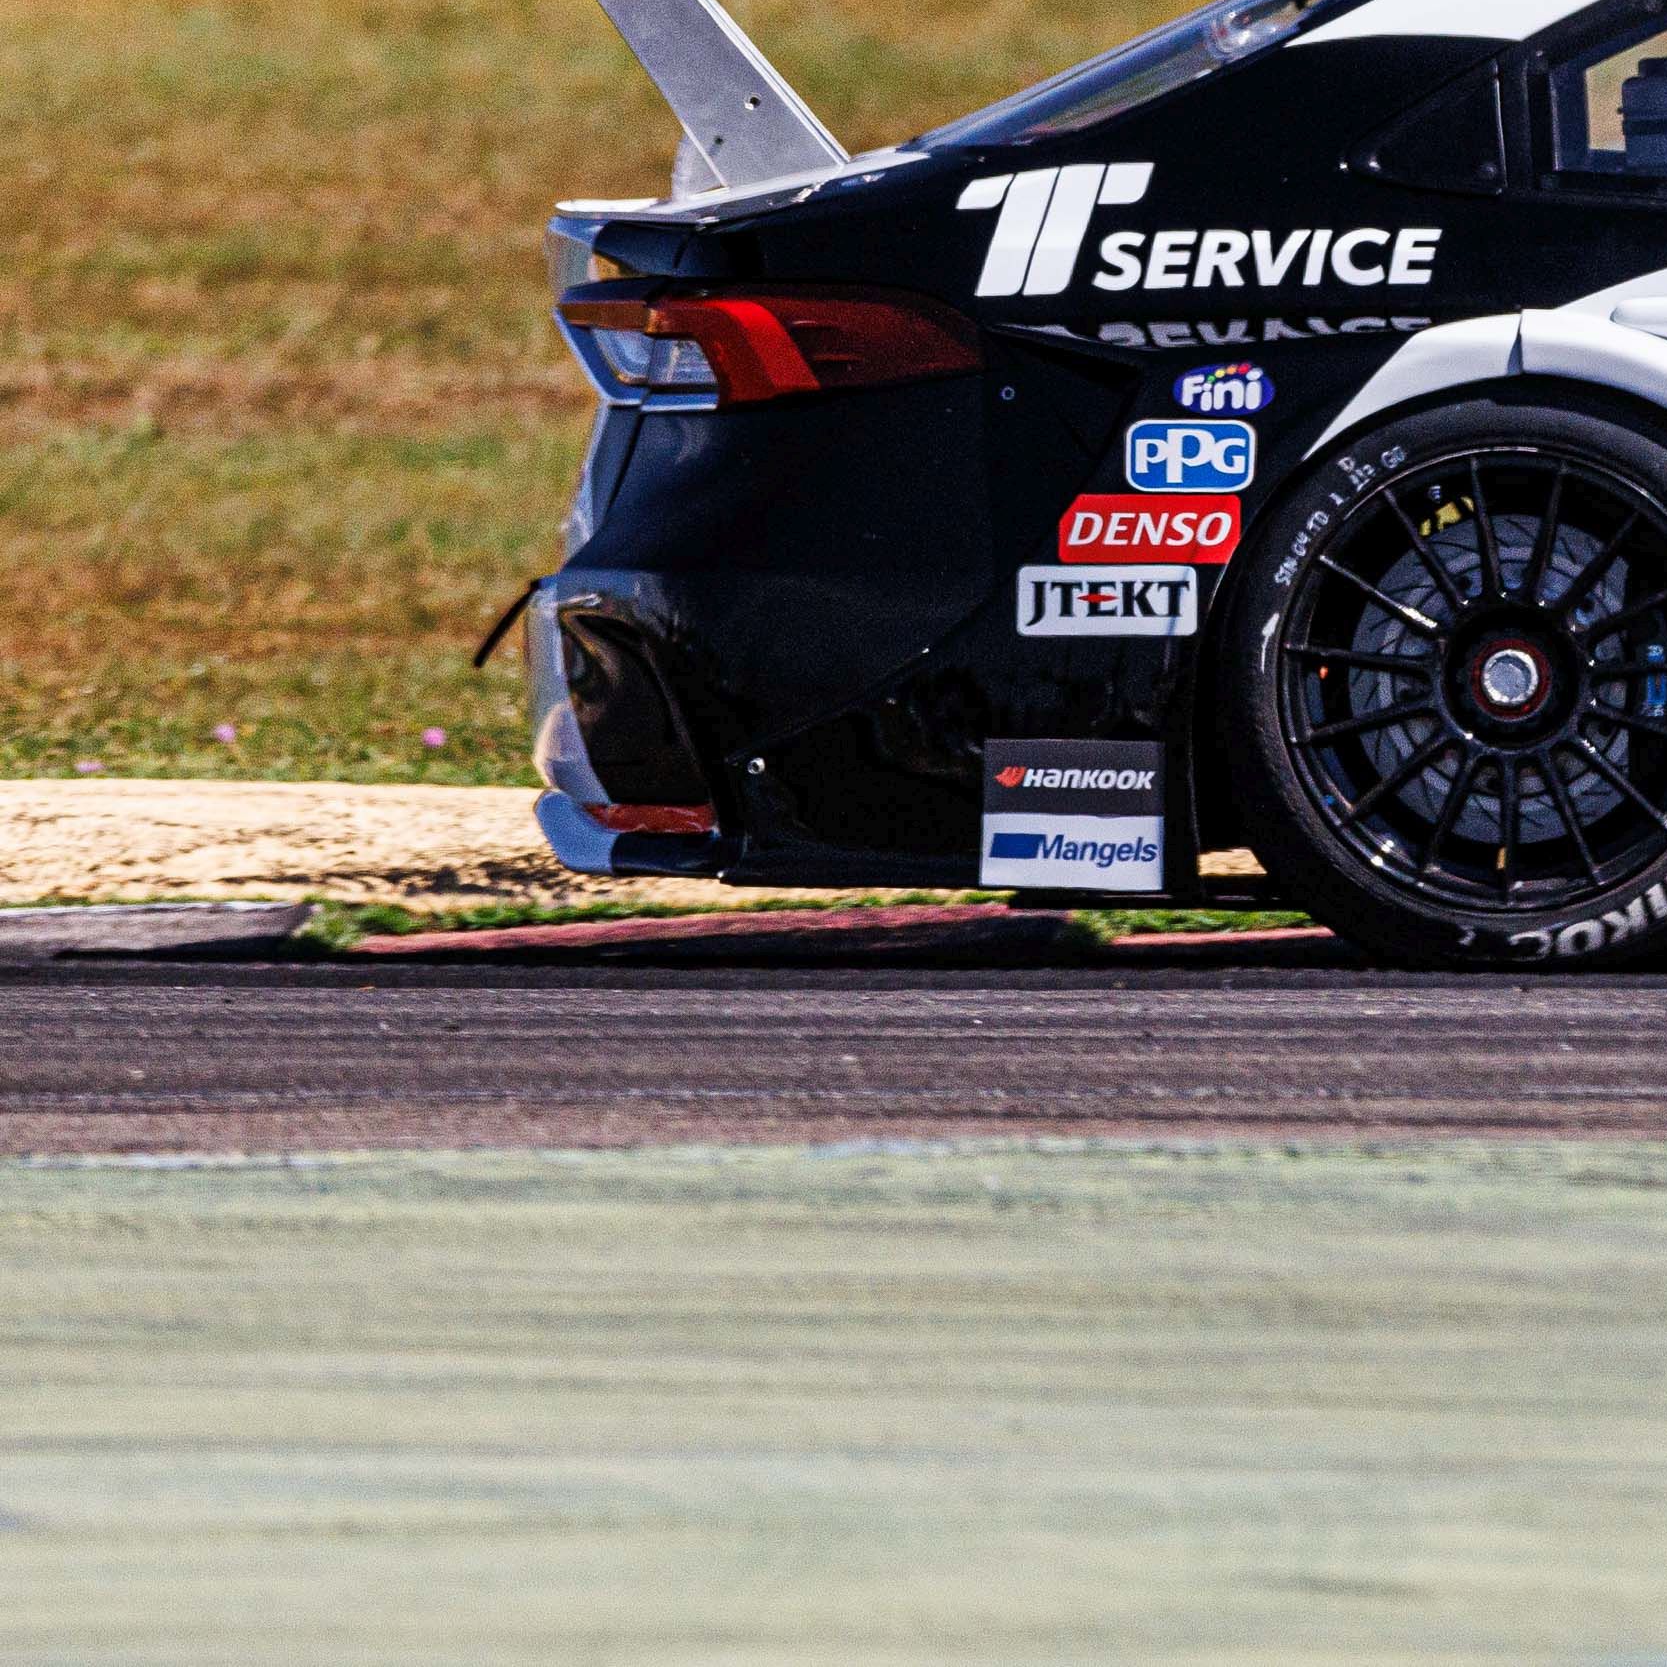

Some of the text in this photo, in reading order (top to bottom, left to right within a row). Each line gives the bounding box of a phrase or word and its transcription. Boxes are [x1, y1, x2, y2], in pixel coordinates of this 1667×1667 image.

[1092, 228, 1442, 292] SERVICE
[1134, 428, 1246, 483] PPG
[1067, 512, 1232, 547] DENSO
[1025, 580, 1190, 627] JTEKT
[1035, 834, 1158, 868] Mangels
